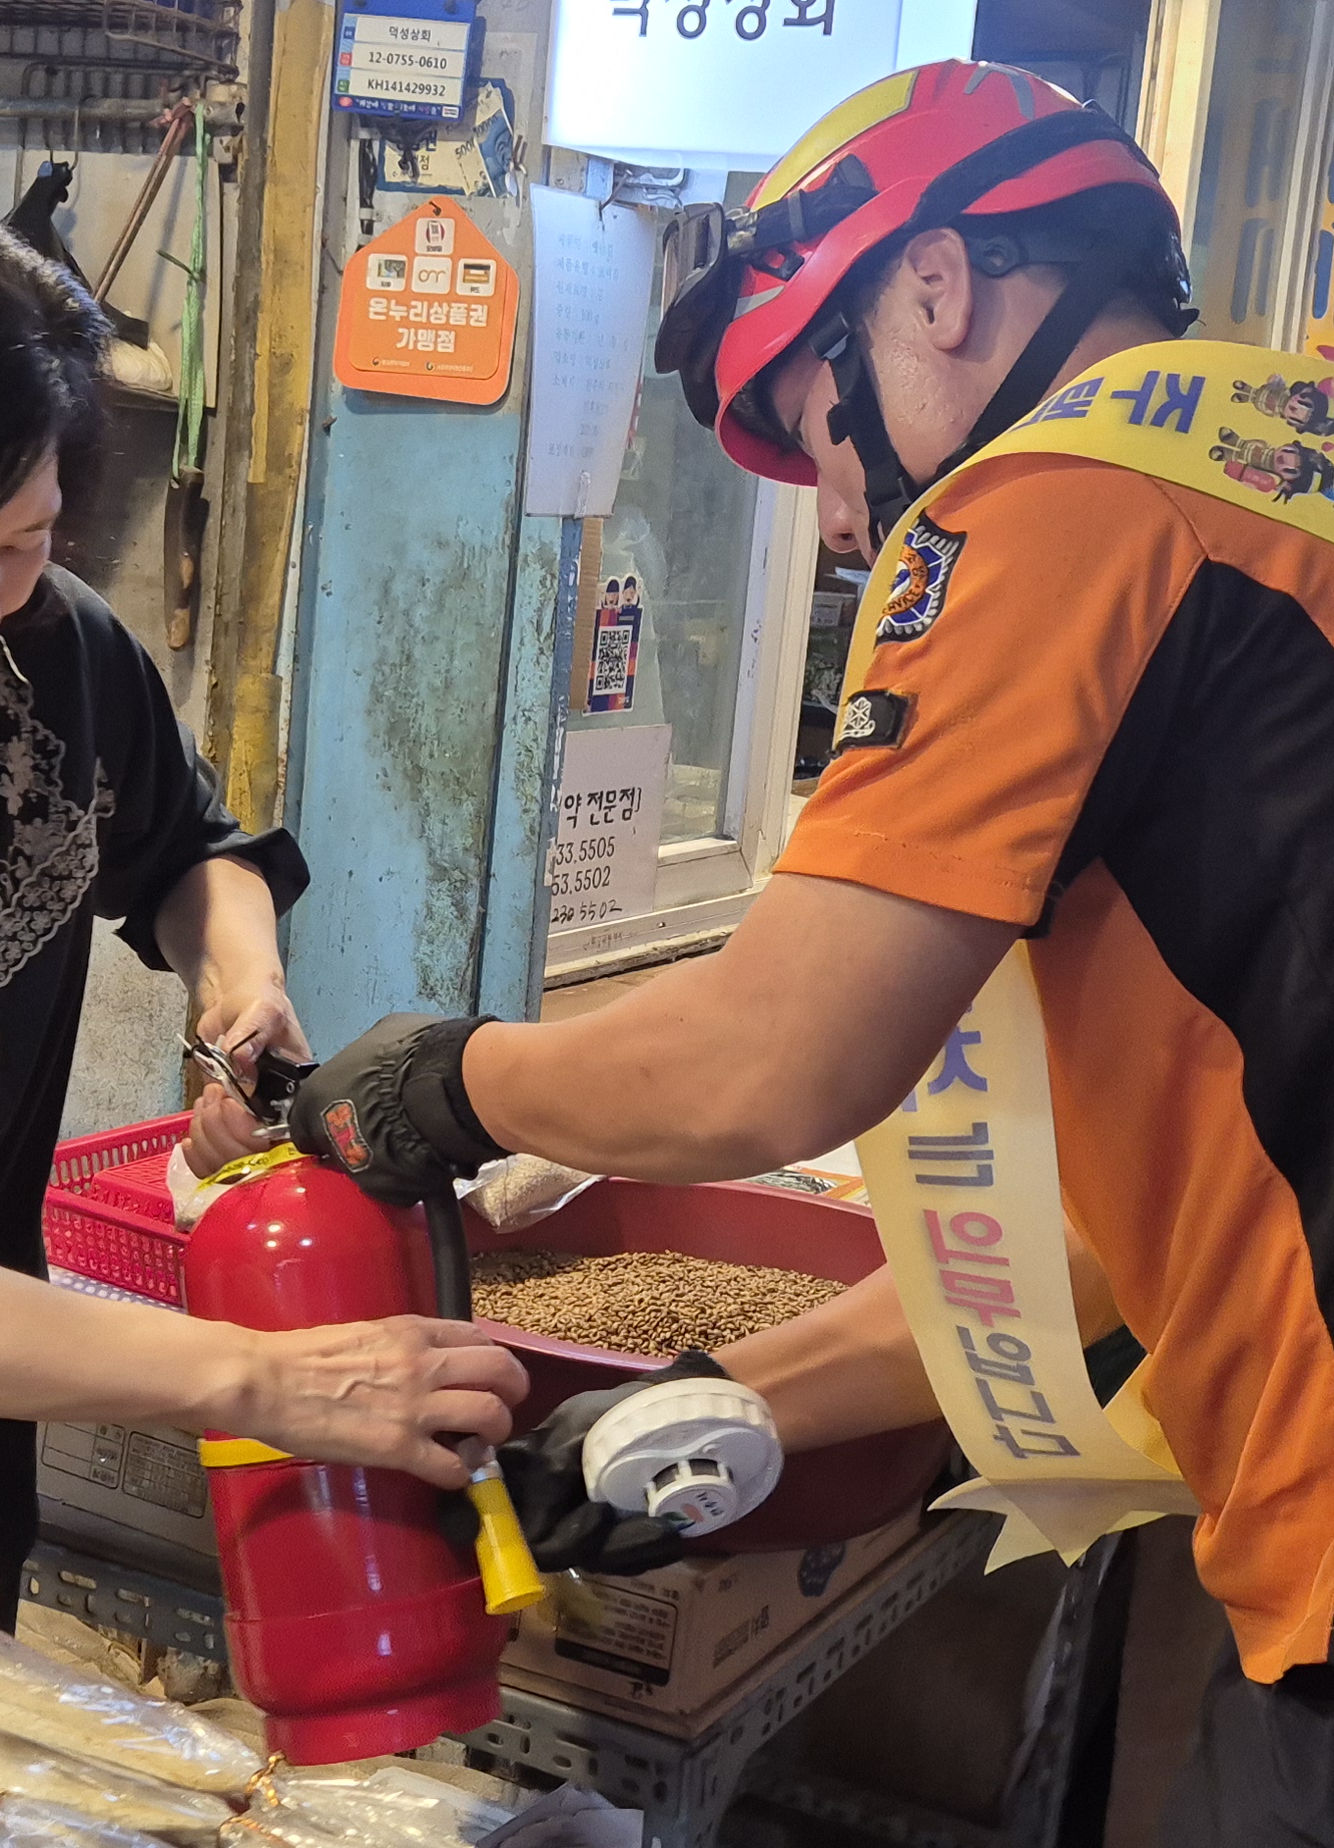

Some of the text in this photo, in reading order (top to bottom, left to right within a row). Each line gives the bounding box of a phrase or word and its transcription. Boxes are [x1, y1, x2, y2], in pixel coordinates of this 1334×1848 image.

[389, 26, 431, 42] 덕성상회
[368, 51, 448, 69] 12-0755-0610
[367, 79, 446, 97] KH141429932
[368, 297, 488, 327] 온누리상품권
[395, 328, 456, 353] 가맹점
